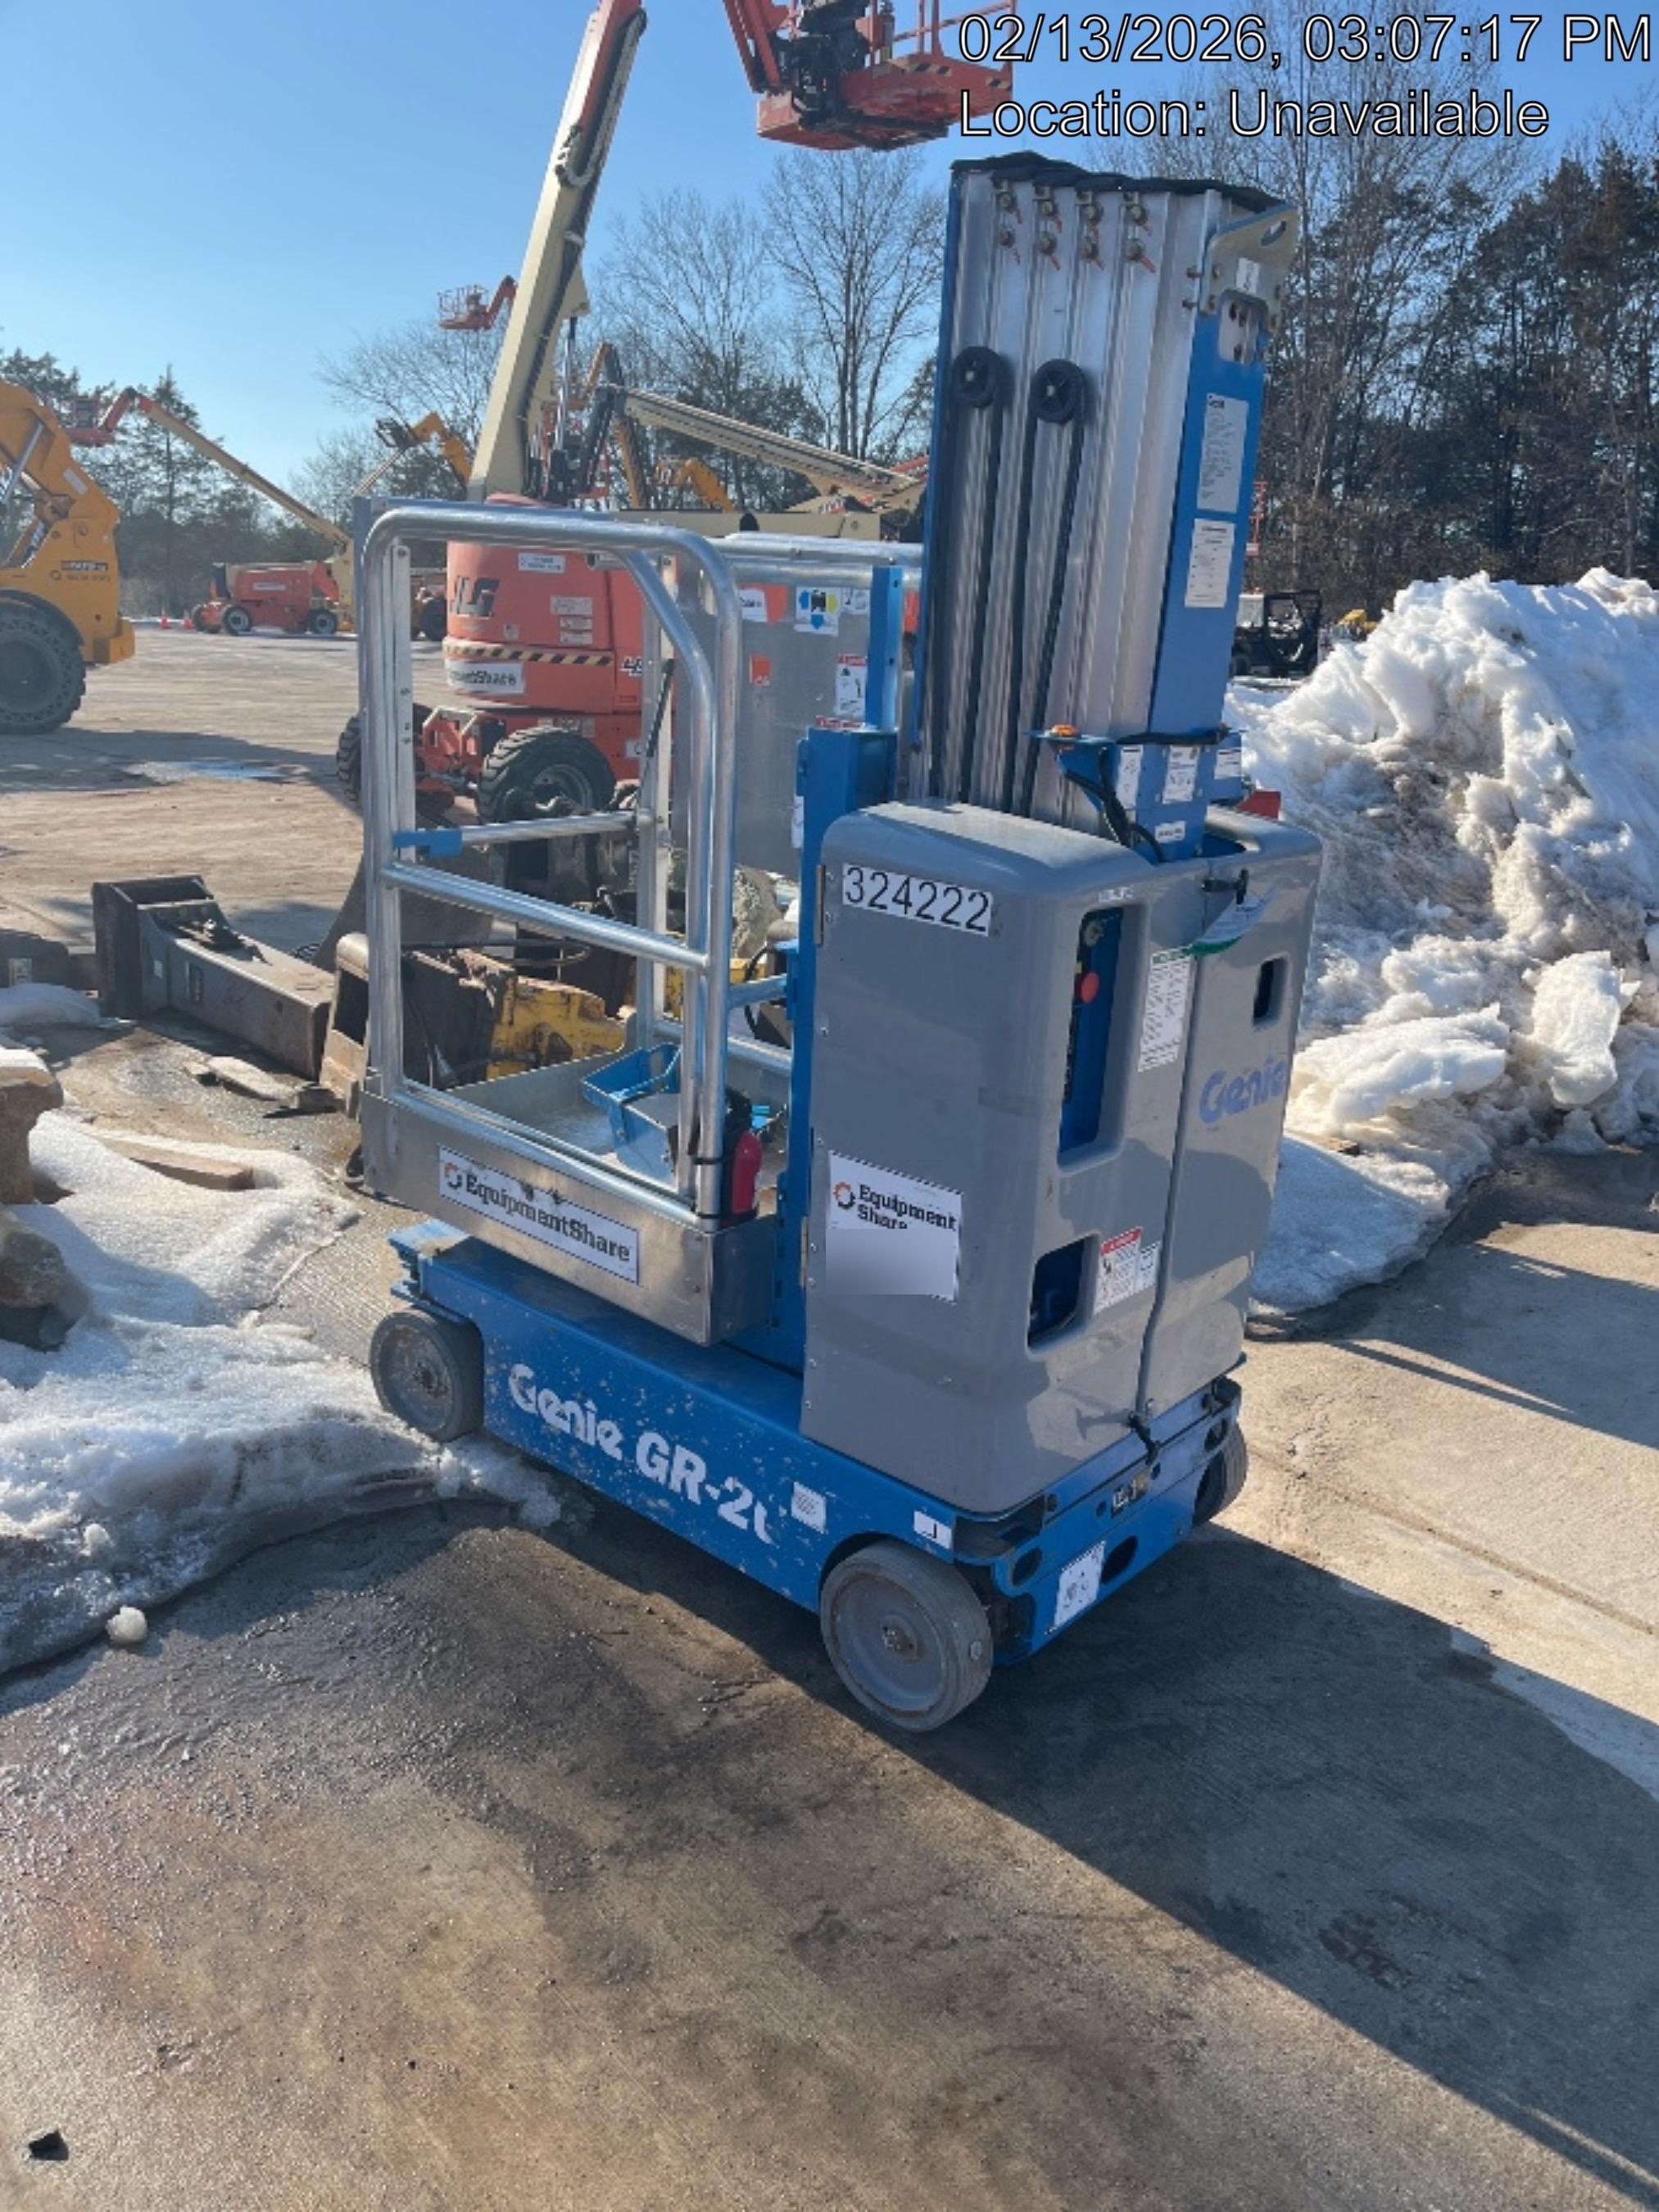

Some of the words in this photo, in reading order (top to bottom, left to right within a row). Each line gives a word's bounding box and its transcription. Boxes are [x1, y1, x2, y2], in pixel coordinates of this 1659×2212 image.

[845, 867, 989, 931] 324222
[1199, 1054, 1289, 1124] Genie
[465, 1173, 630, 1262] EquipmentShare
[859, 1184, 957, 1231] Equipment
[508, 1363, 623, 1462] Genie
